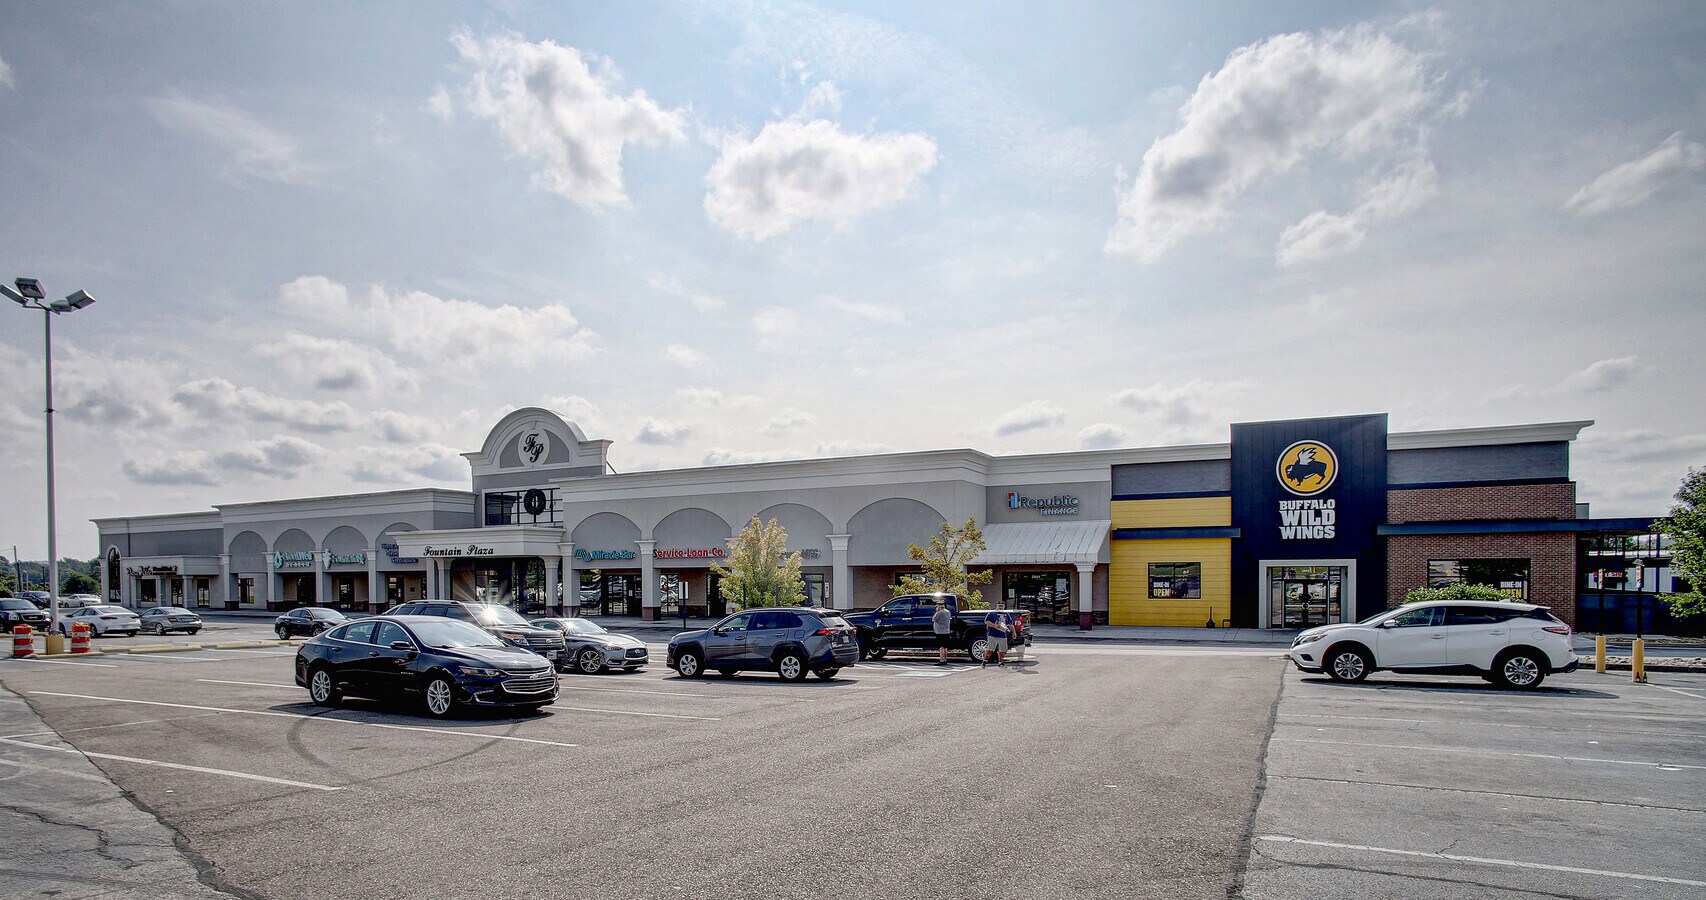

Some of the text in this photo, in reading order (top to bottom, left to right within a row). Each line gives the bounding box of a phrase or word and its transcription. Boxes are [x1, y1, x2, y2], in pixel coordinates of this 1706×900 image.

[1020, 495, 1079, 509] Republic
[1279, 499, 1336, 510] BUFFALO
[1279, 510, 1336, 526] WILD
[1279, 526, 1336, 540] WINGS
[423, 544, 494, 557] Fountain Plaza
[653, 547, 727, 558] Service Loan Co.
[1153, 588, 1170, 597] OPEN
